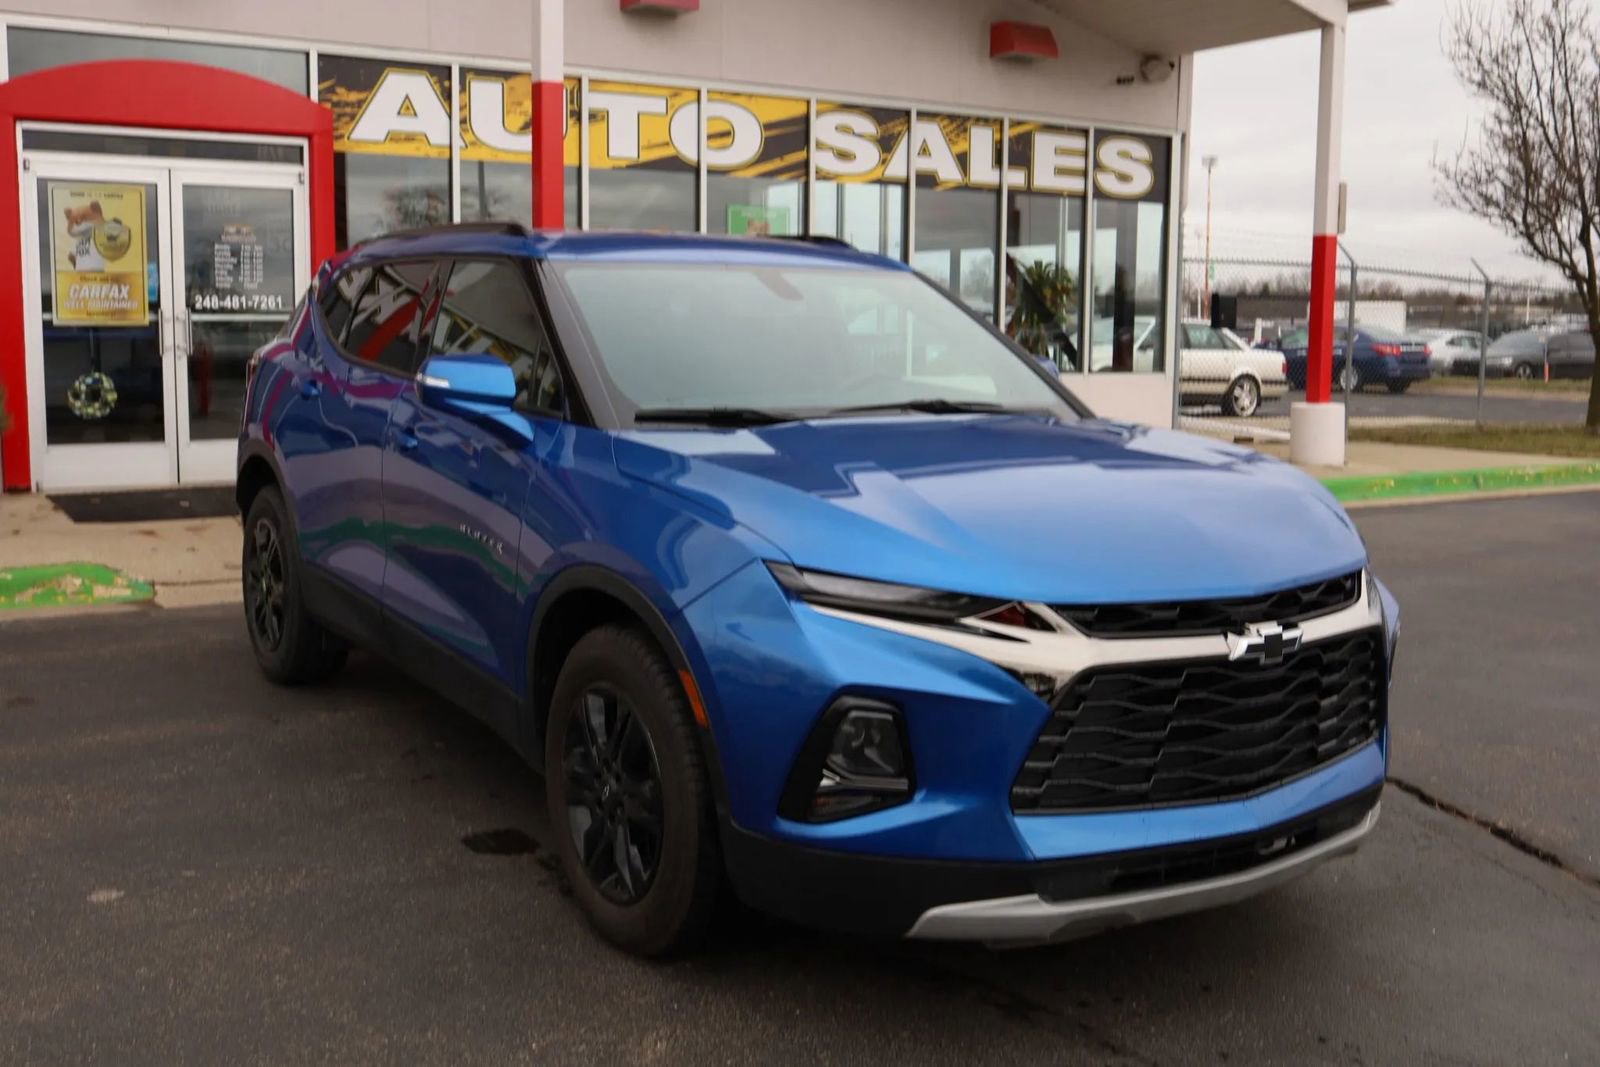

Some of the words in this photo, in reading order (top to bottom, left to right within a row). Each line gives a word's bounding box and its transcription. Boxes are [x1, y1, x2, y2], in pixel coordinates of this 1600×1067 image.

[347, 68, 765, 169] AUTO
[814, 108, 1154, 197] SALES
[69, 283, 131, 299] CARFAX
